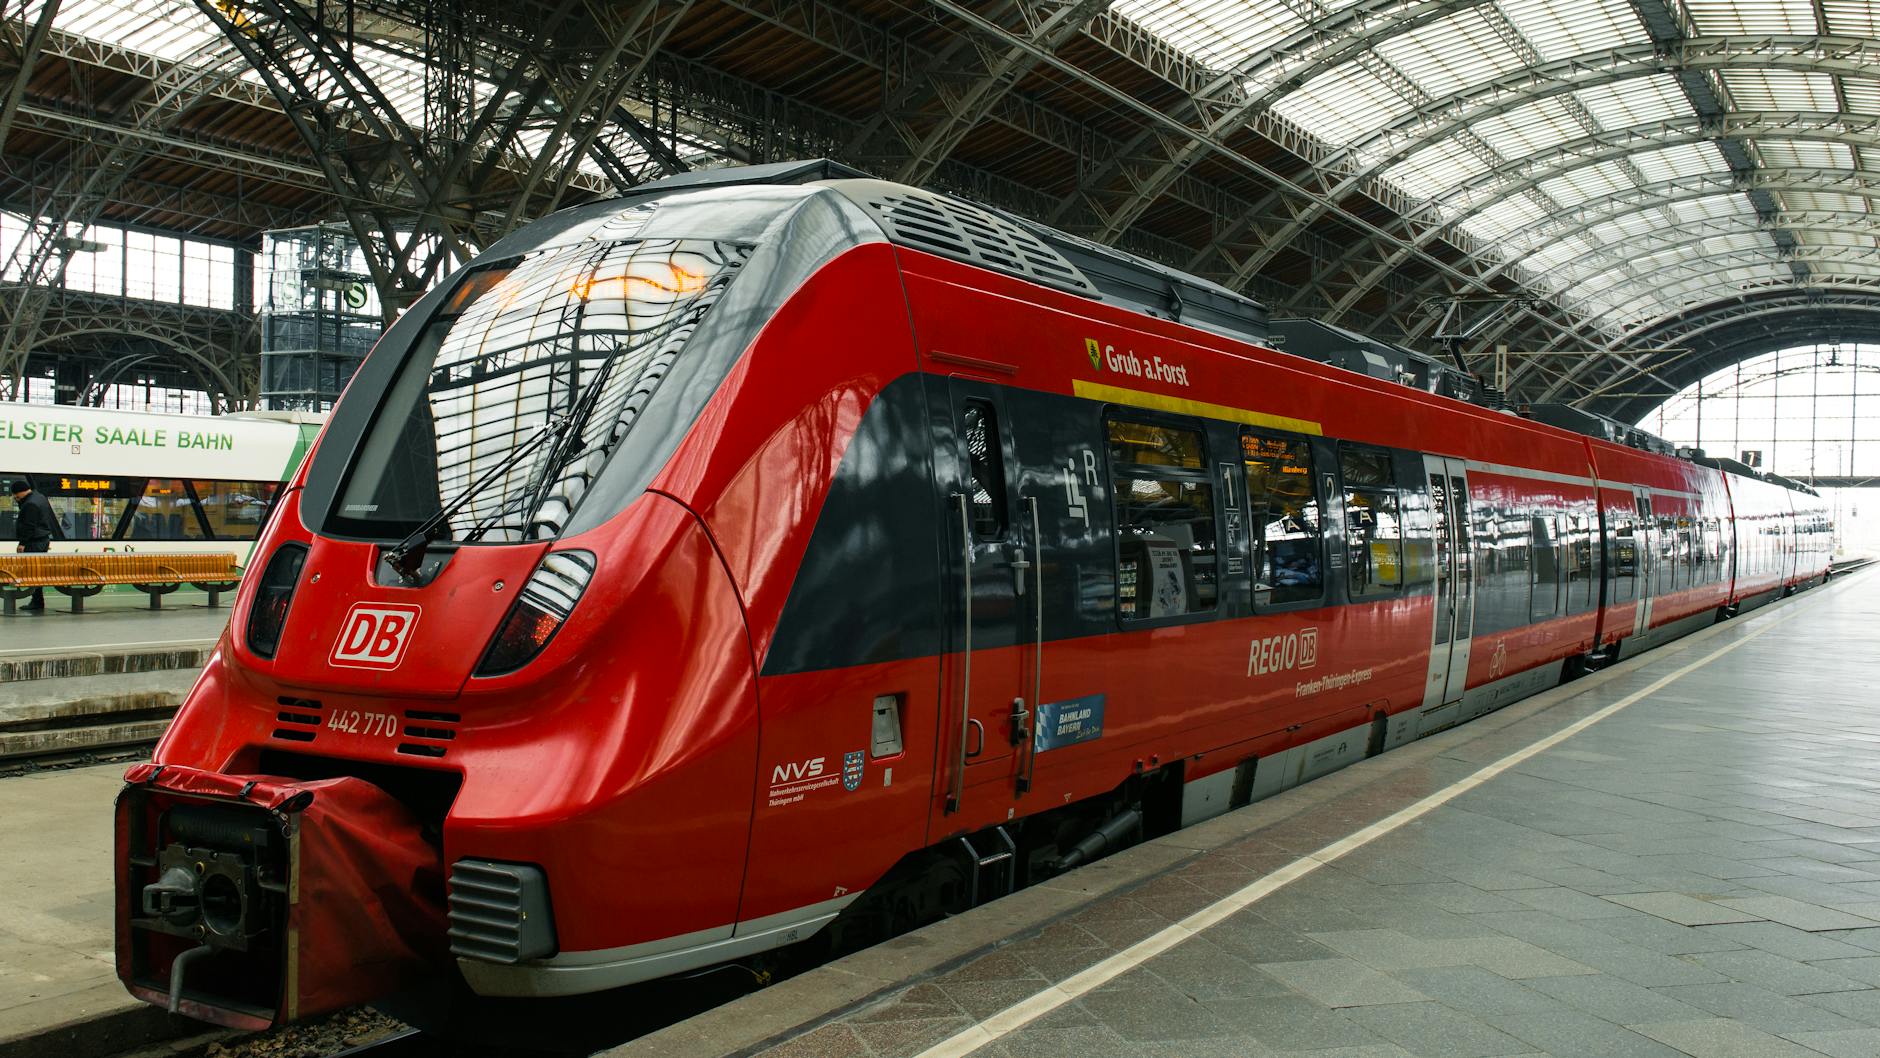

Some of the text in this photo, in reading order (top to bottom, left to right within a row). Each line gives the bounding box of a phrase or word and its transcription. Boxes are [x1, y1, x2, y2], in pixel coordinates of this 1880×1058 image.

[348, 282, 365, 308] S
[1105, 344, 1142, 378] Grub
[95, 426, 167, 448] SAALE
[177, 431, 233, 451] BAHN
[1083, 449, 1098, 487] R
[1748, 451, 1755, 466] 7
[1223, 466, 1234, 507] 1
[338, 611, 409, 660] DB
[1247, 632, 1317, 677] REGIO DB
[1295, 668, 1373, 698] Franken-Thüringen-Express
[327, 708, 397, 737] 442 770
[1057, 721, 1082, 736] BAYERN
[1058, 708, 1092, 724] BAHNLAND
[771, 756, 826, 784] NVS
